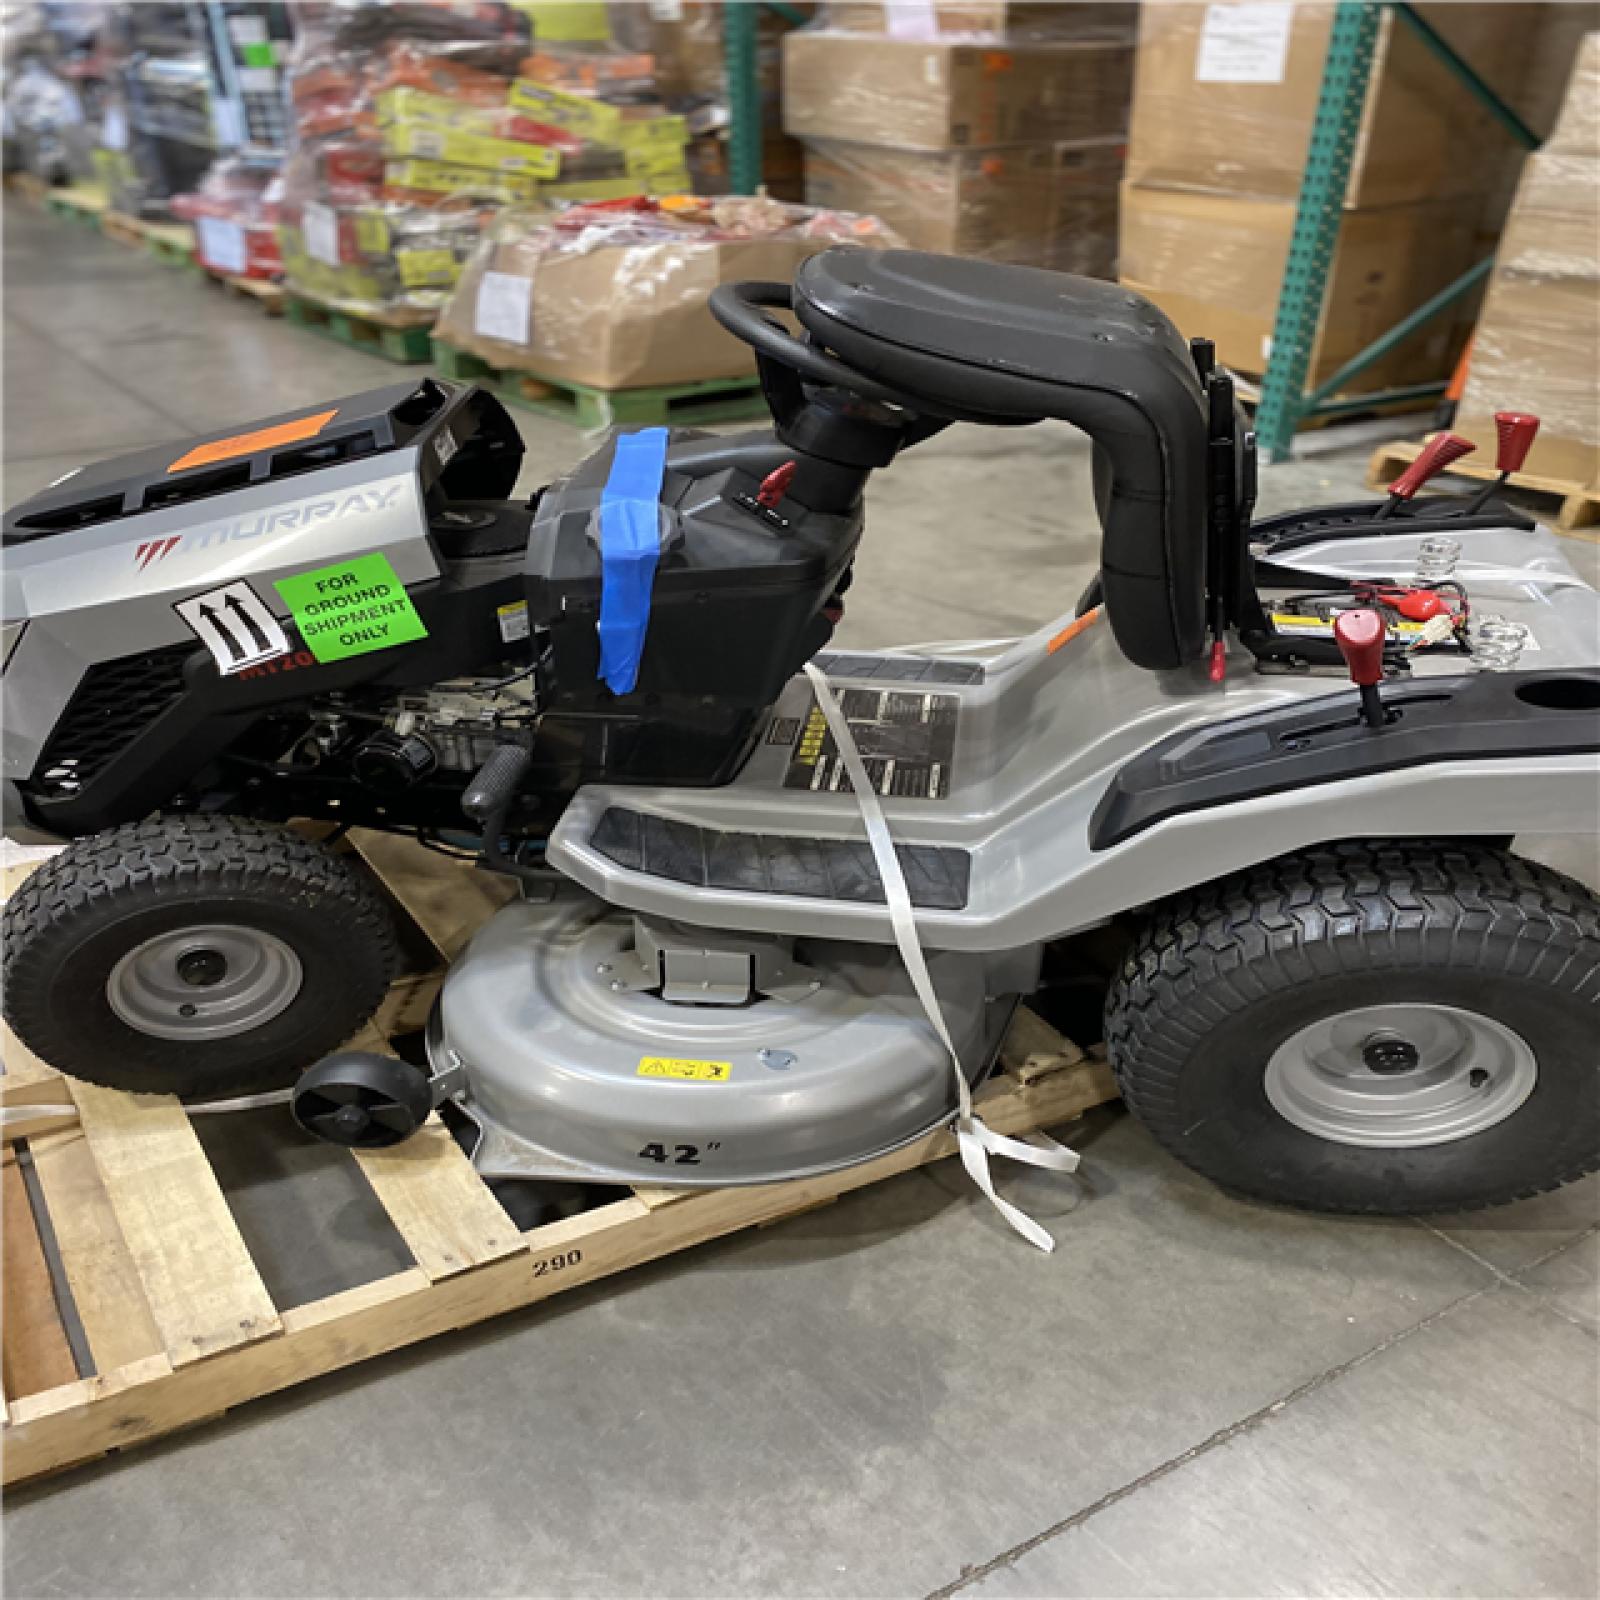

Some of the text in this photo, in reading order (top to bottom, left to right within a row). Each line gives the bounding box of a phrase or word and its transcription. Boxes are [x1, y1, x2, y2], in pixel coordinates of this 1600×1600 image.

[183, 483, 402, 551] MURRAY
[315, 573, 359, 593] FOR
[304, 584, 391, 616] GROUND
[304, 598, 406, 636] SHIPMENT
[339, 623, 389, 646] ONLY
[532, 1249, 583, 1278] 290
